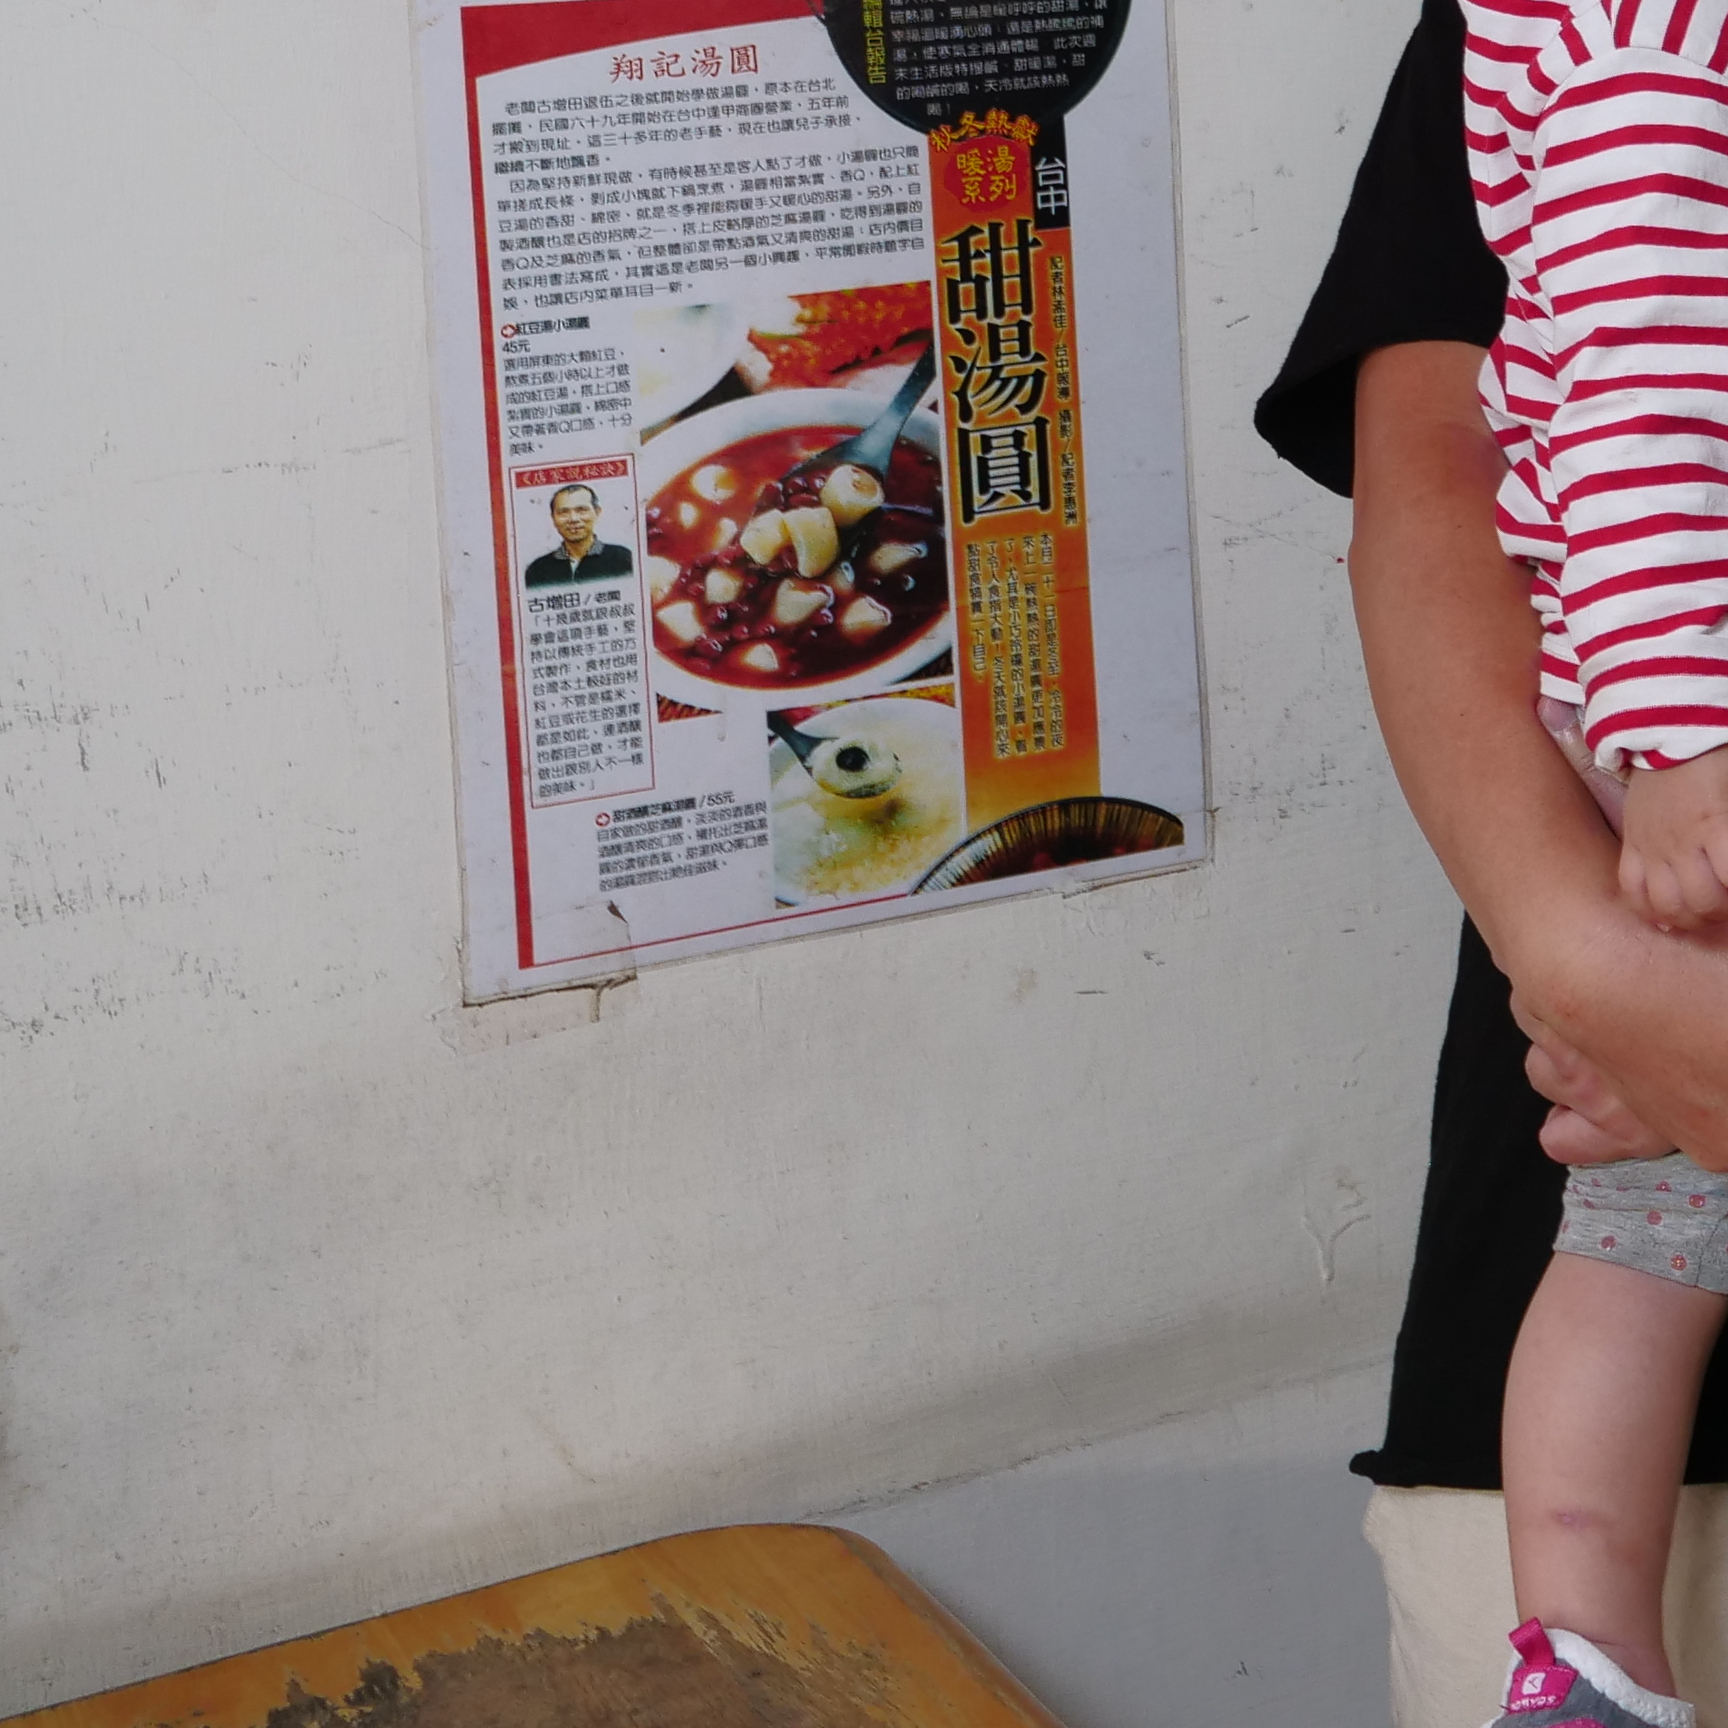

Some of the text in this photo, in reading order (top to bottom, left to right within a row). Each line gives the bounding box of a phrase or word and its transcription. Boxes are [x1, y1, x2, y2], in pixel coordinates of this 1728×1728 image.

[610, 44, 759, 83] 翔記湯圓
[956, 145, 1015, 175] 暖湯
[961, 175, 1017, 203] 系列
[1035, 156, 1067, 215] 台中
[941, 218, 1052, 525] 甜湯圓
